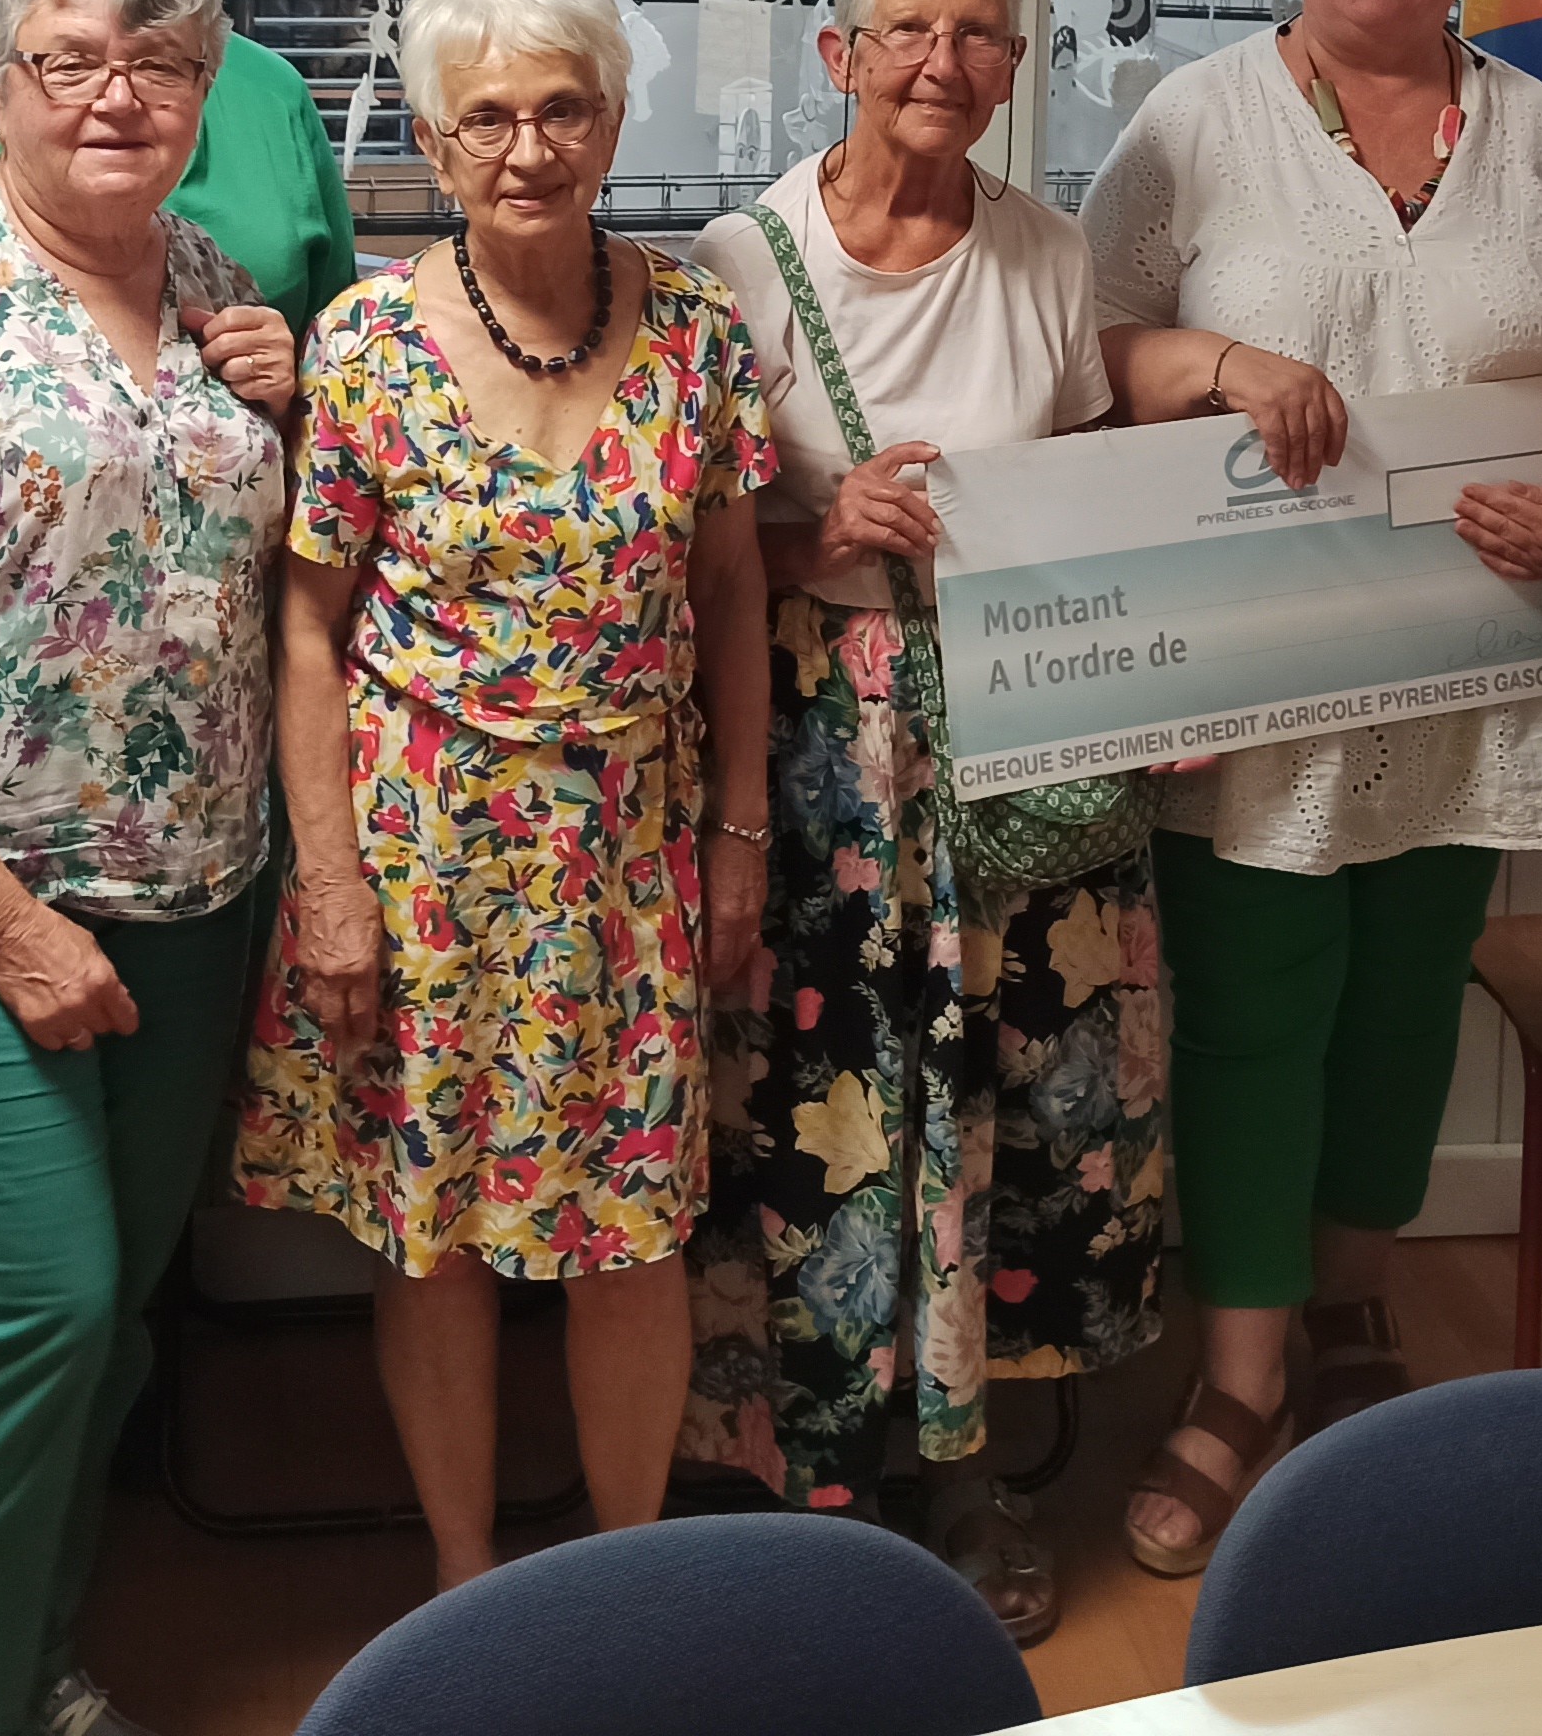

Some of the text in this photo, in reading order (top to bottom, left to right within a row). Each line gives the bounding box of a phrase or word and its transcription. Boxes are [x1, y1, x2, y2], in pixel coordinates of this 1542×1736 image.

[1278, 494, 1357, 516] GASCOGNE
[982, 585, 1129, 638] Montant
[988, 658, 1012, 695] A
[1148, 630, 1188, 669] de
[959, 751, 1055, 789] CHEQUE
[1059, 728, 1174, 770] SPECIMEN
[1179, 713, 1260, 748] CREDIT
[1265, 694, 1374, 734] AGRICOLE
[1378, 674, 1489, 713] PYRENEES
